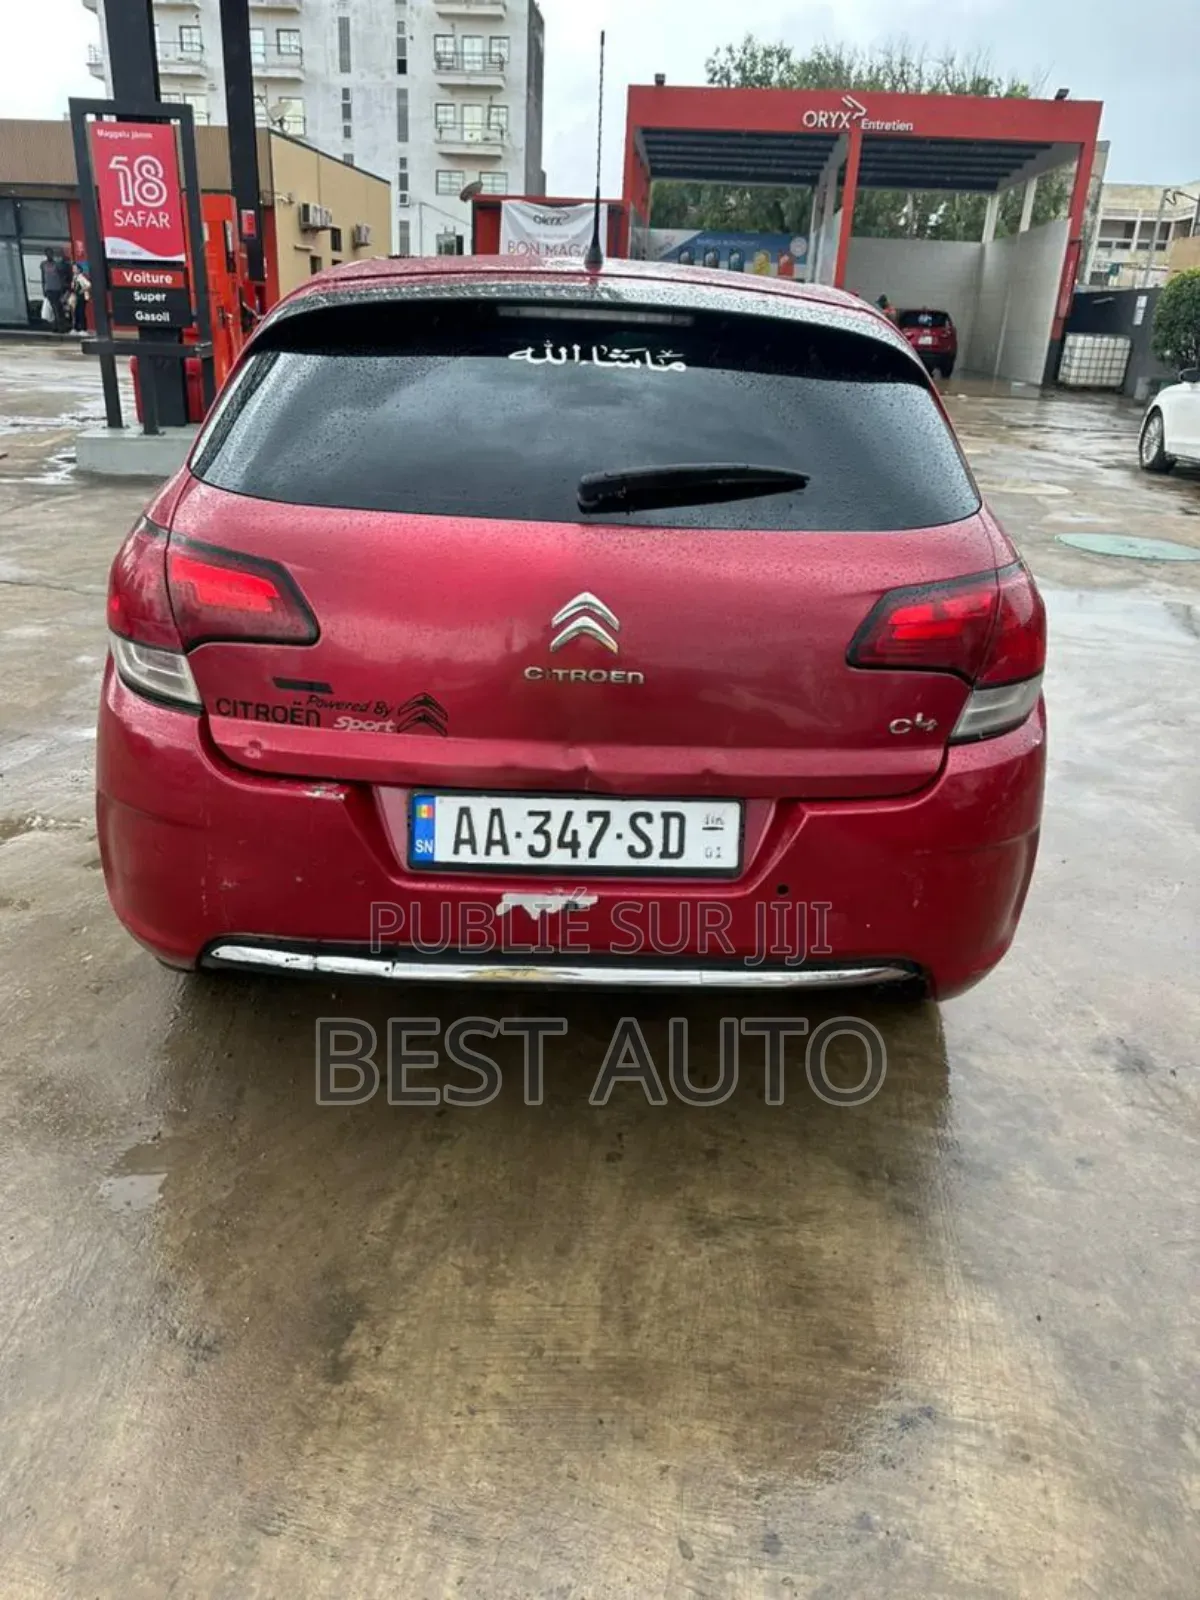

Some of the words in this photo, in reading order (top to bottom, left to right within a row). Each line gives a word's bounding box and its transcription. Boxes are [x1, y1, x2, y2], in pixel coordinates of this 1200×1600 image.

[802, 110, 850, 128] ORYX
[861, 118, 913, 131] Entretien
[109, 155, 167, 207] 18
[113, 209, 170, 229] SAFAR
[507, 240, 540, 256] BON
[123, 271, 173, 284] Voiture
[133, 291, 166, 303] Super
[135, 310, 170, 322] Gasoil
[307, 694, 372, 713] Powered
[373, 700, 394, 718] By
[333, 716, 395, 732] Sport
[889, 712, 938, 734] C4
[415, 839, 434, 853] SN
